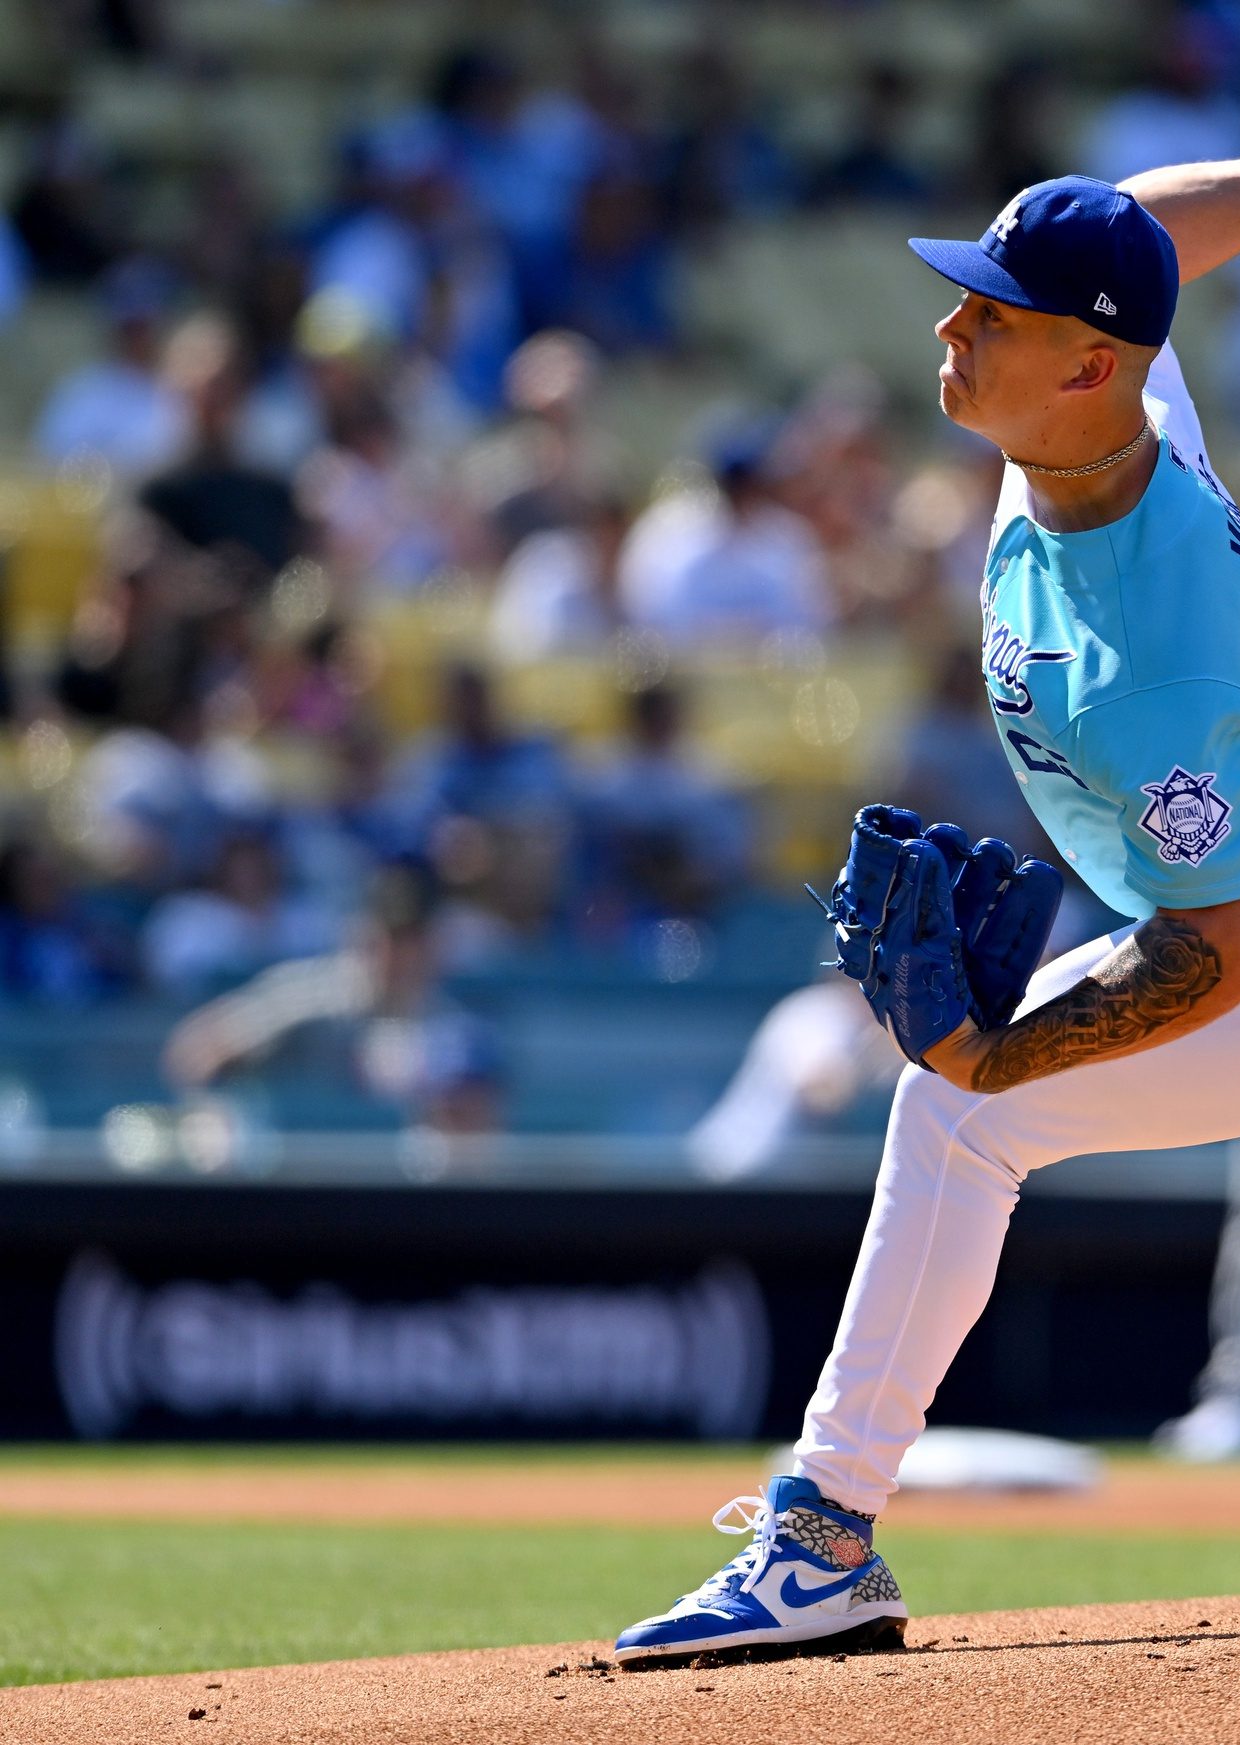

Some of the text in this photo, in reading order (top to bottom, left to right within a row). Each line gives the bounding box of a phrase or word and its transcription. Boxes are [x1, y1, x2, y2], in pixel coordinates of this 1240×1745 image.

[1169, 803, 1203, 825] NATIONAL
[894, 952, 912, 1038] Bobby Miller
